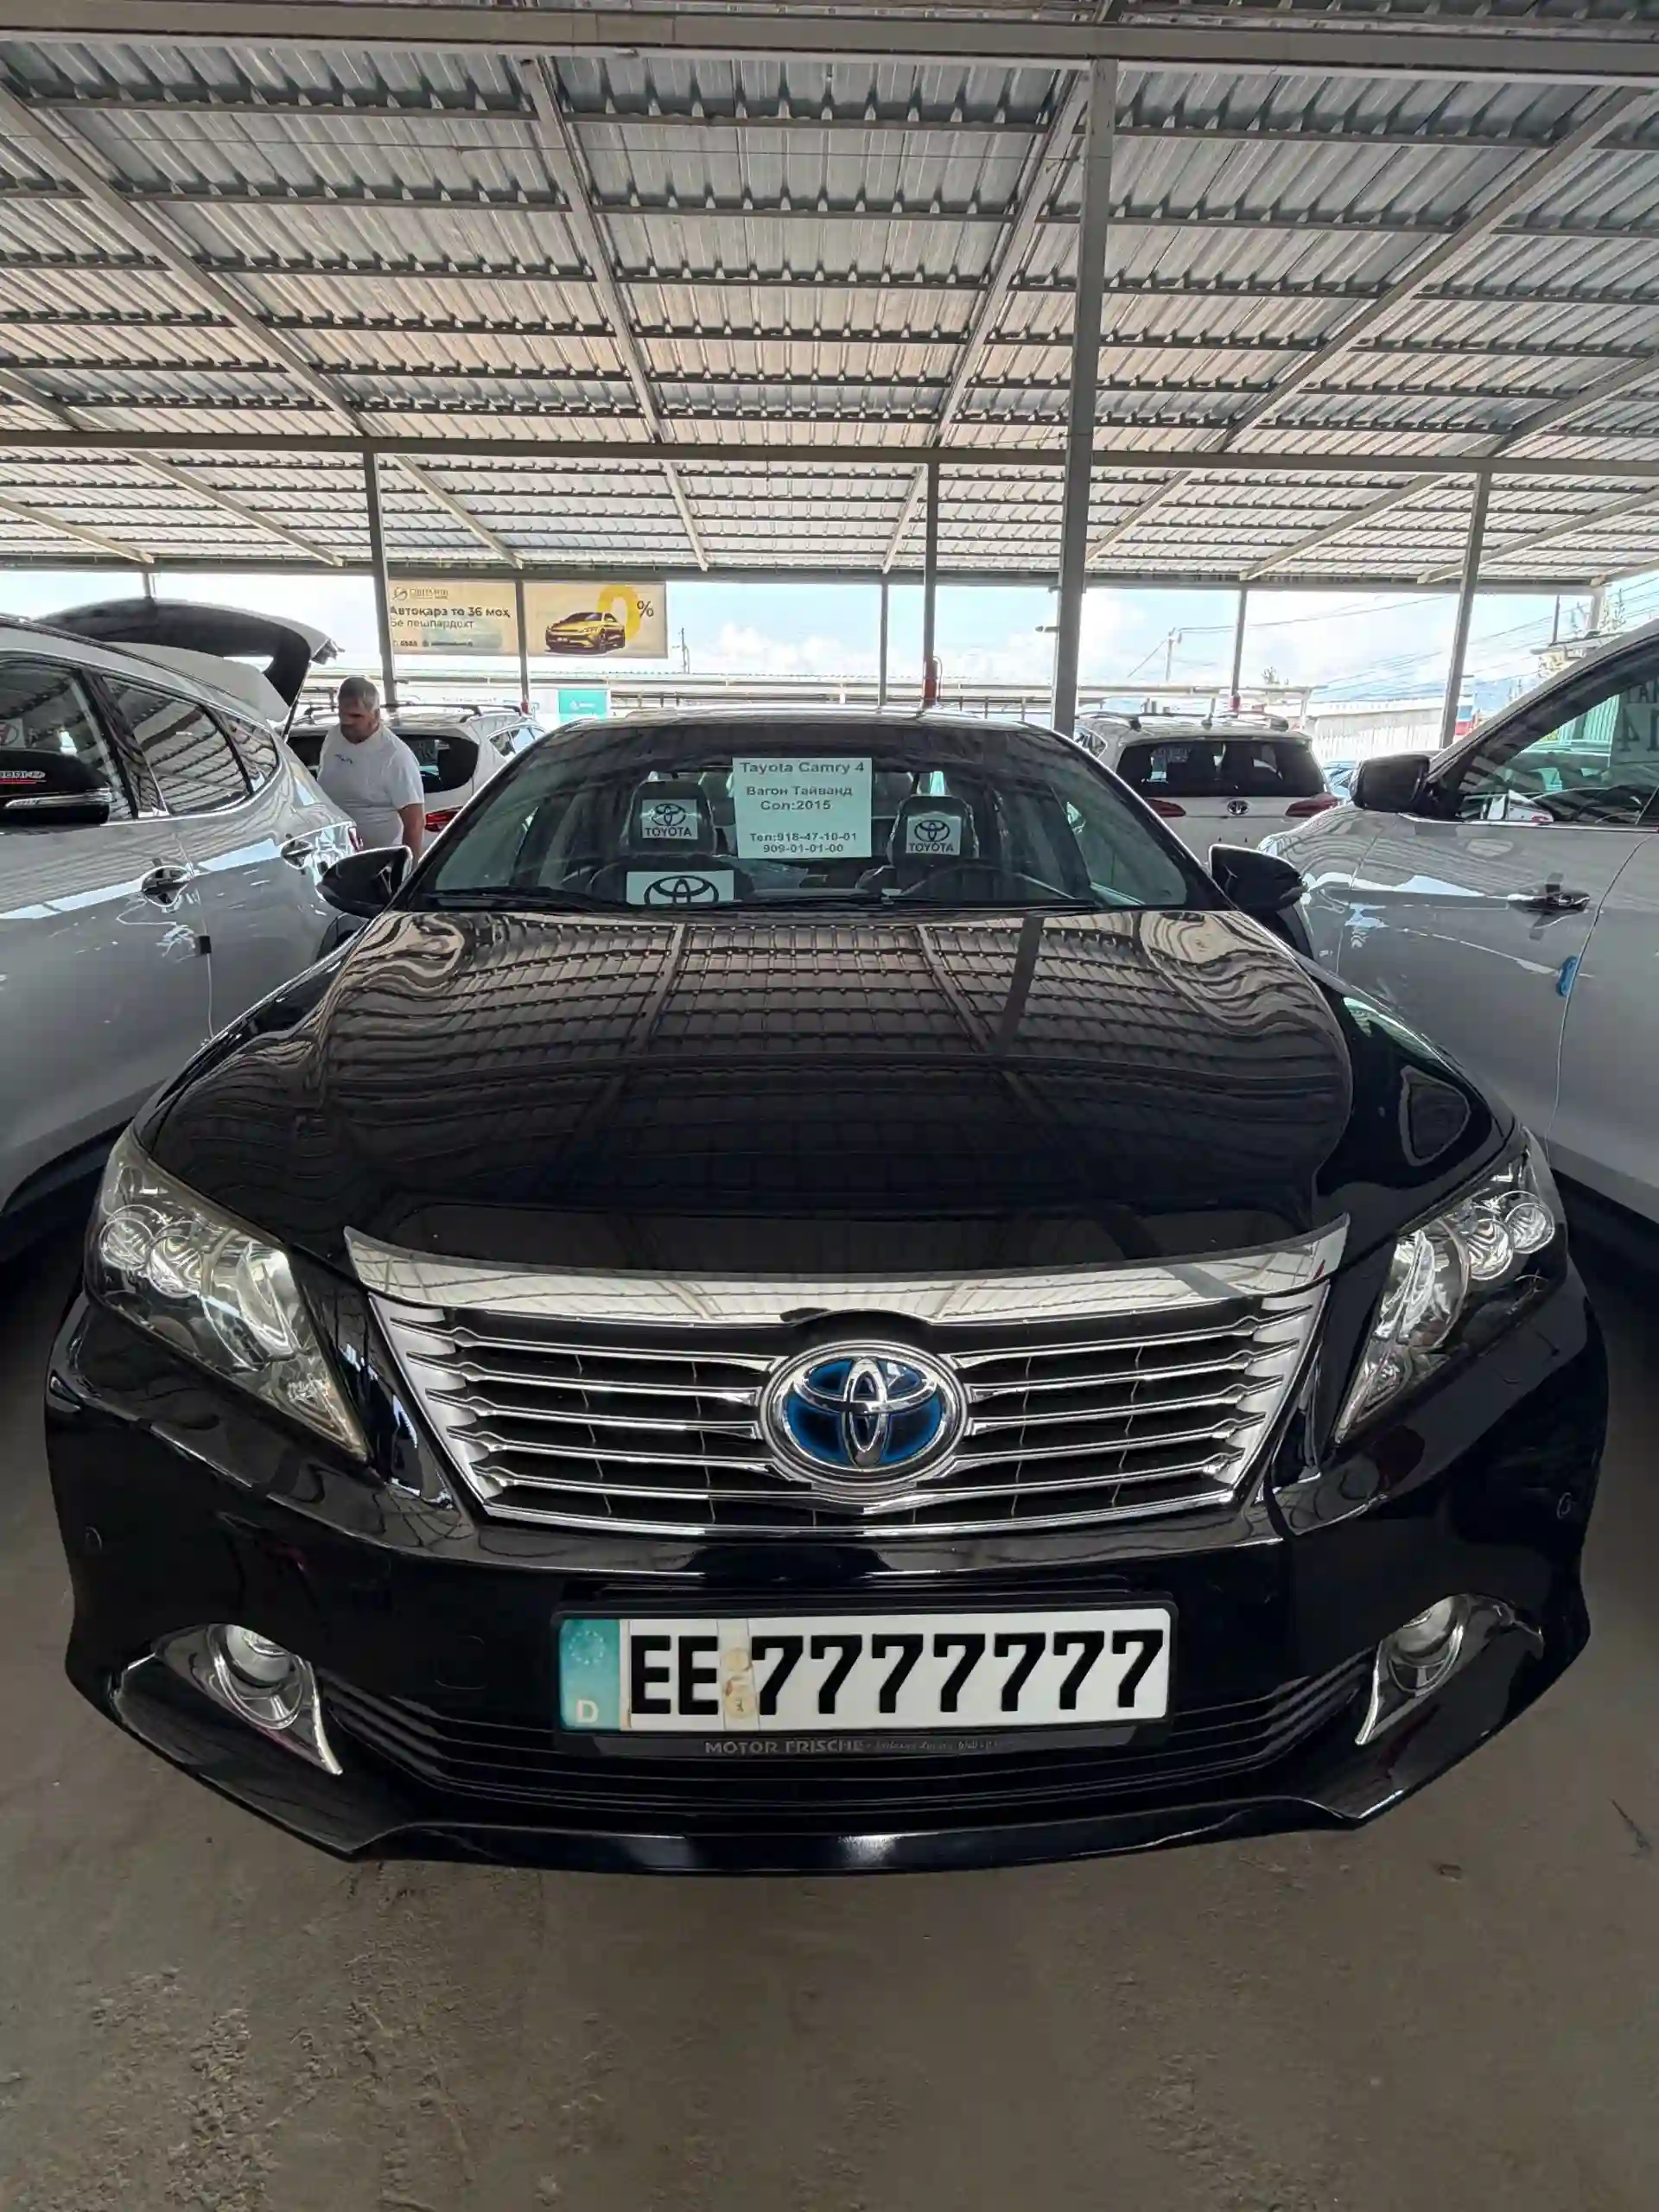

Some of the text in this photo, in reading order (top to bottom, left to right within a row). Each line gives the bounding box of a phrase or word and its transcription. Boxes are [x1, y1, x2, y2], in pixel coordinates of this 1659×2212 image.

[467, 607, 483, 616] 36
[740, 762, 865, 774] Tayota Camry 4
[747, 785, 853, 797] Вагон Тайванд
[645, 827, 692, 837] TOYOTA
[763, 844, 844, 854] 909-01-01-00
[909, 842, 954, 852] TOYOTA
[631, 1630, 1164, 1716] EE 7777777
[576, 1699, 600, 1724] D
[704, 1740, 779, 1755] MOTOR
